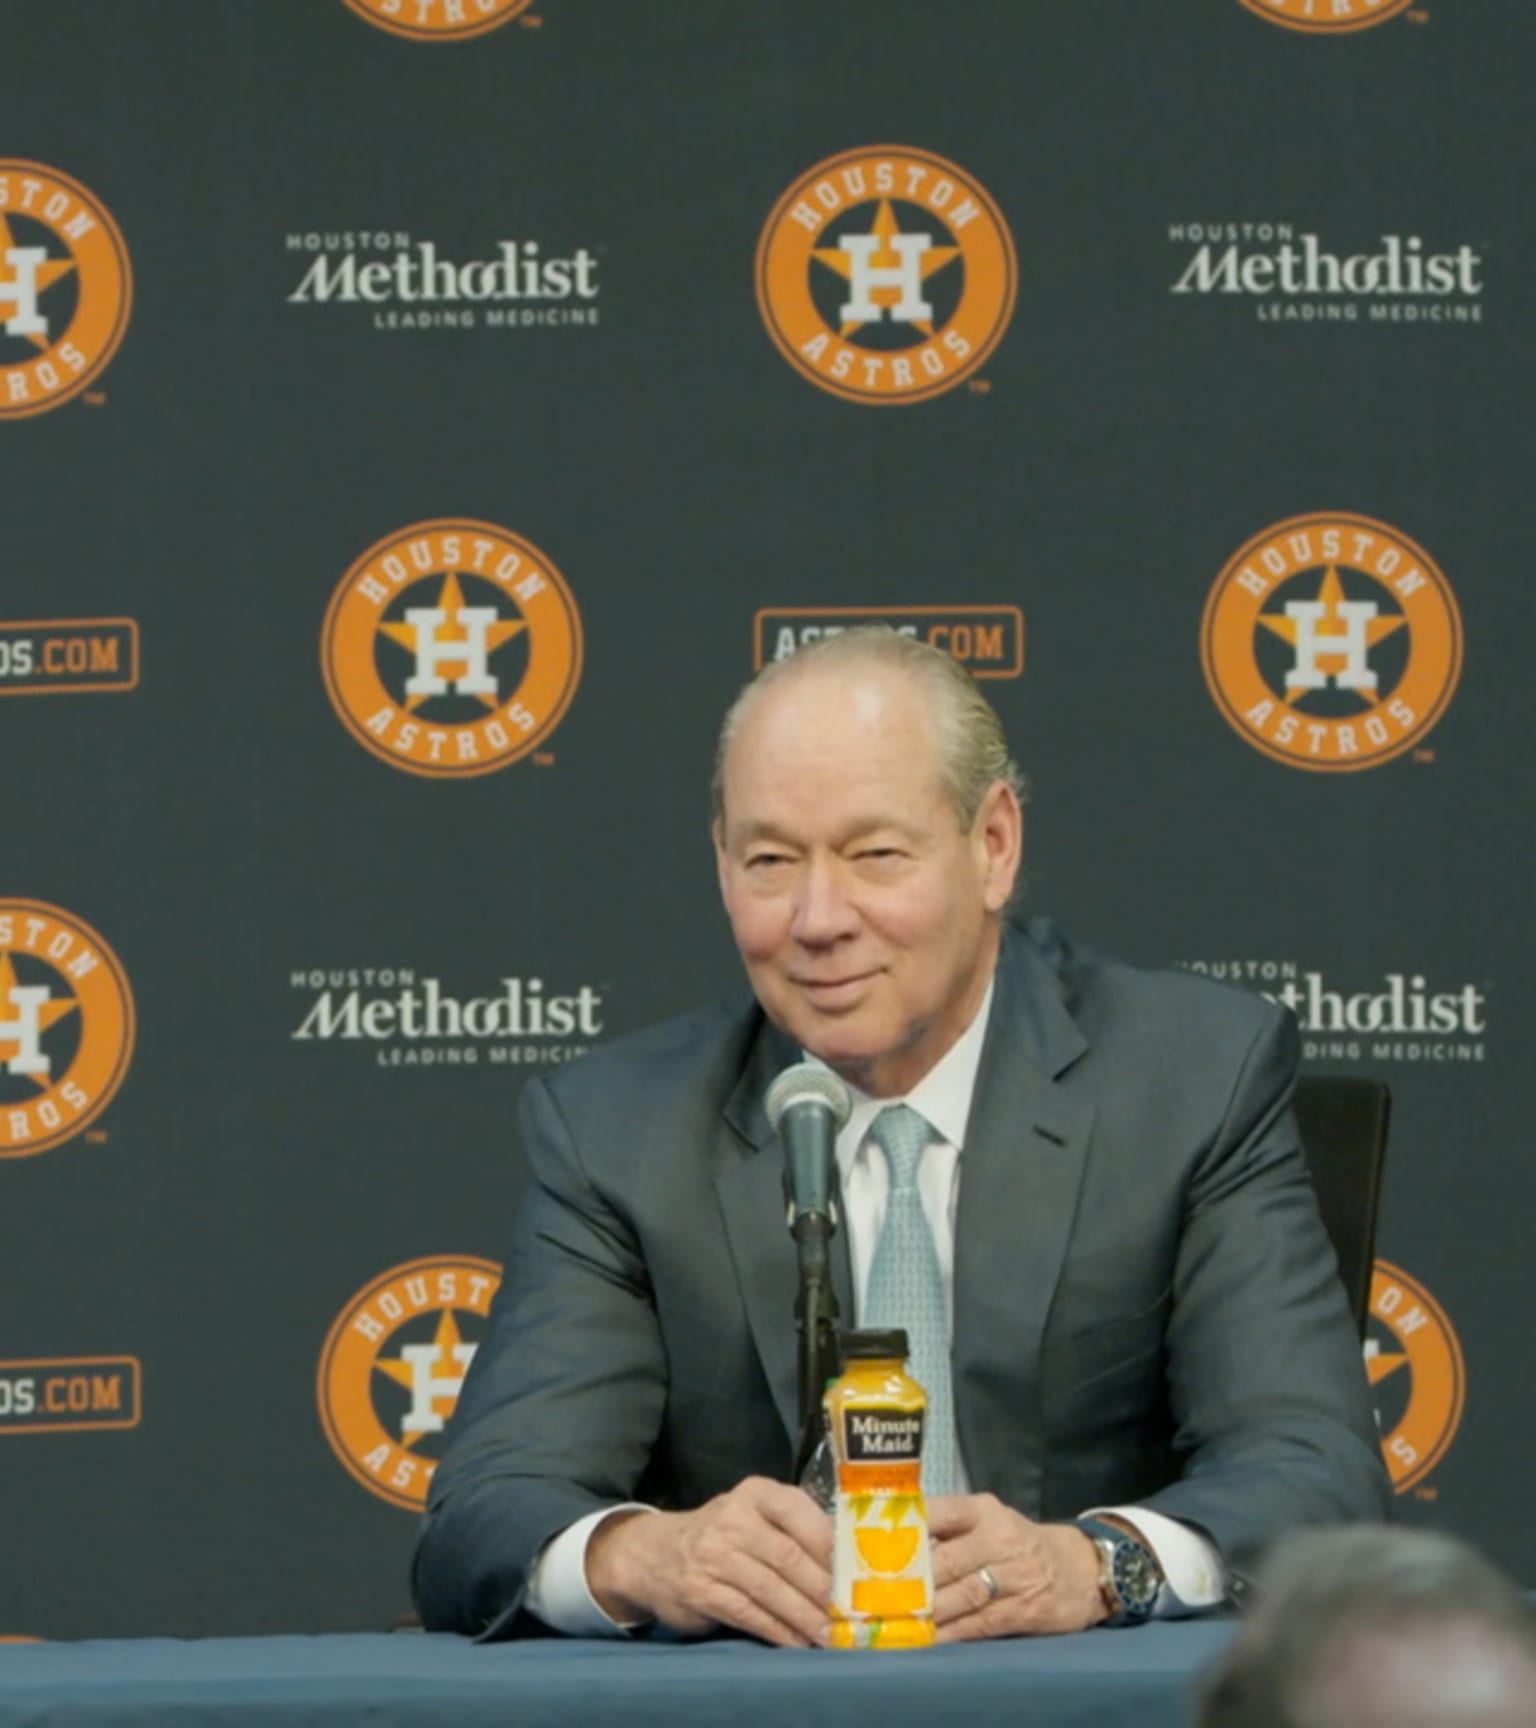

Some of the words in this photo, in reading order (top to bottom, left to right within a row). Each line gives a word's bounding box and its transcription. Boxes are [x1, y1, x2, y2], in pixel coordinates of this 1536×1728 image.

[791, 162, 981, 232] HOUSTON
[286, 232, 411, 250] HOUSTON
[1169, 224, 1293, 242] HOUSTON
[286, 241, 599, 303] Methodist
[838, 232, 934, 322] H
[1170, 234, 1483, 295] Methodist
[374, 311, 475, 329] LEADING
[486, 308, 600, 326] MEDICINE
[1257, 303, 1358, 321] LEADING
[1369, 304, 1483, 322] MEDICINE
[801, 330, 971, 387] ASTROS
[356, 535, 546, 604] HOUSTON
[1235, 529, 1427, 597] HOUSTON
[404, 606, 499, 695] H
[1284, 600, 1378, 689] H
[366, 703, 535, 760] ASTROS
[1245, 698, 1415, 755] ASTROS
[290, 969, 415, 988] HOUSTON
[290, 978, 603, 1040] Methodist
[377, 1048, 478, 1066] LEADING
[1372, 1042, 1485, 1061] MEDICINE
[353, 1272, 490, 1342] HOUST
[852, 1416, 920, 1434] Minute
[862, 1434, 913, 1453] Maid
